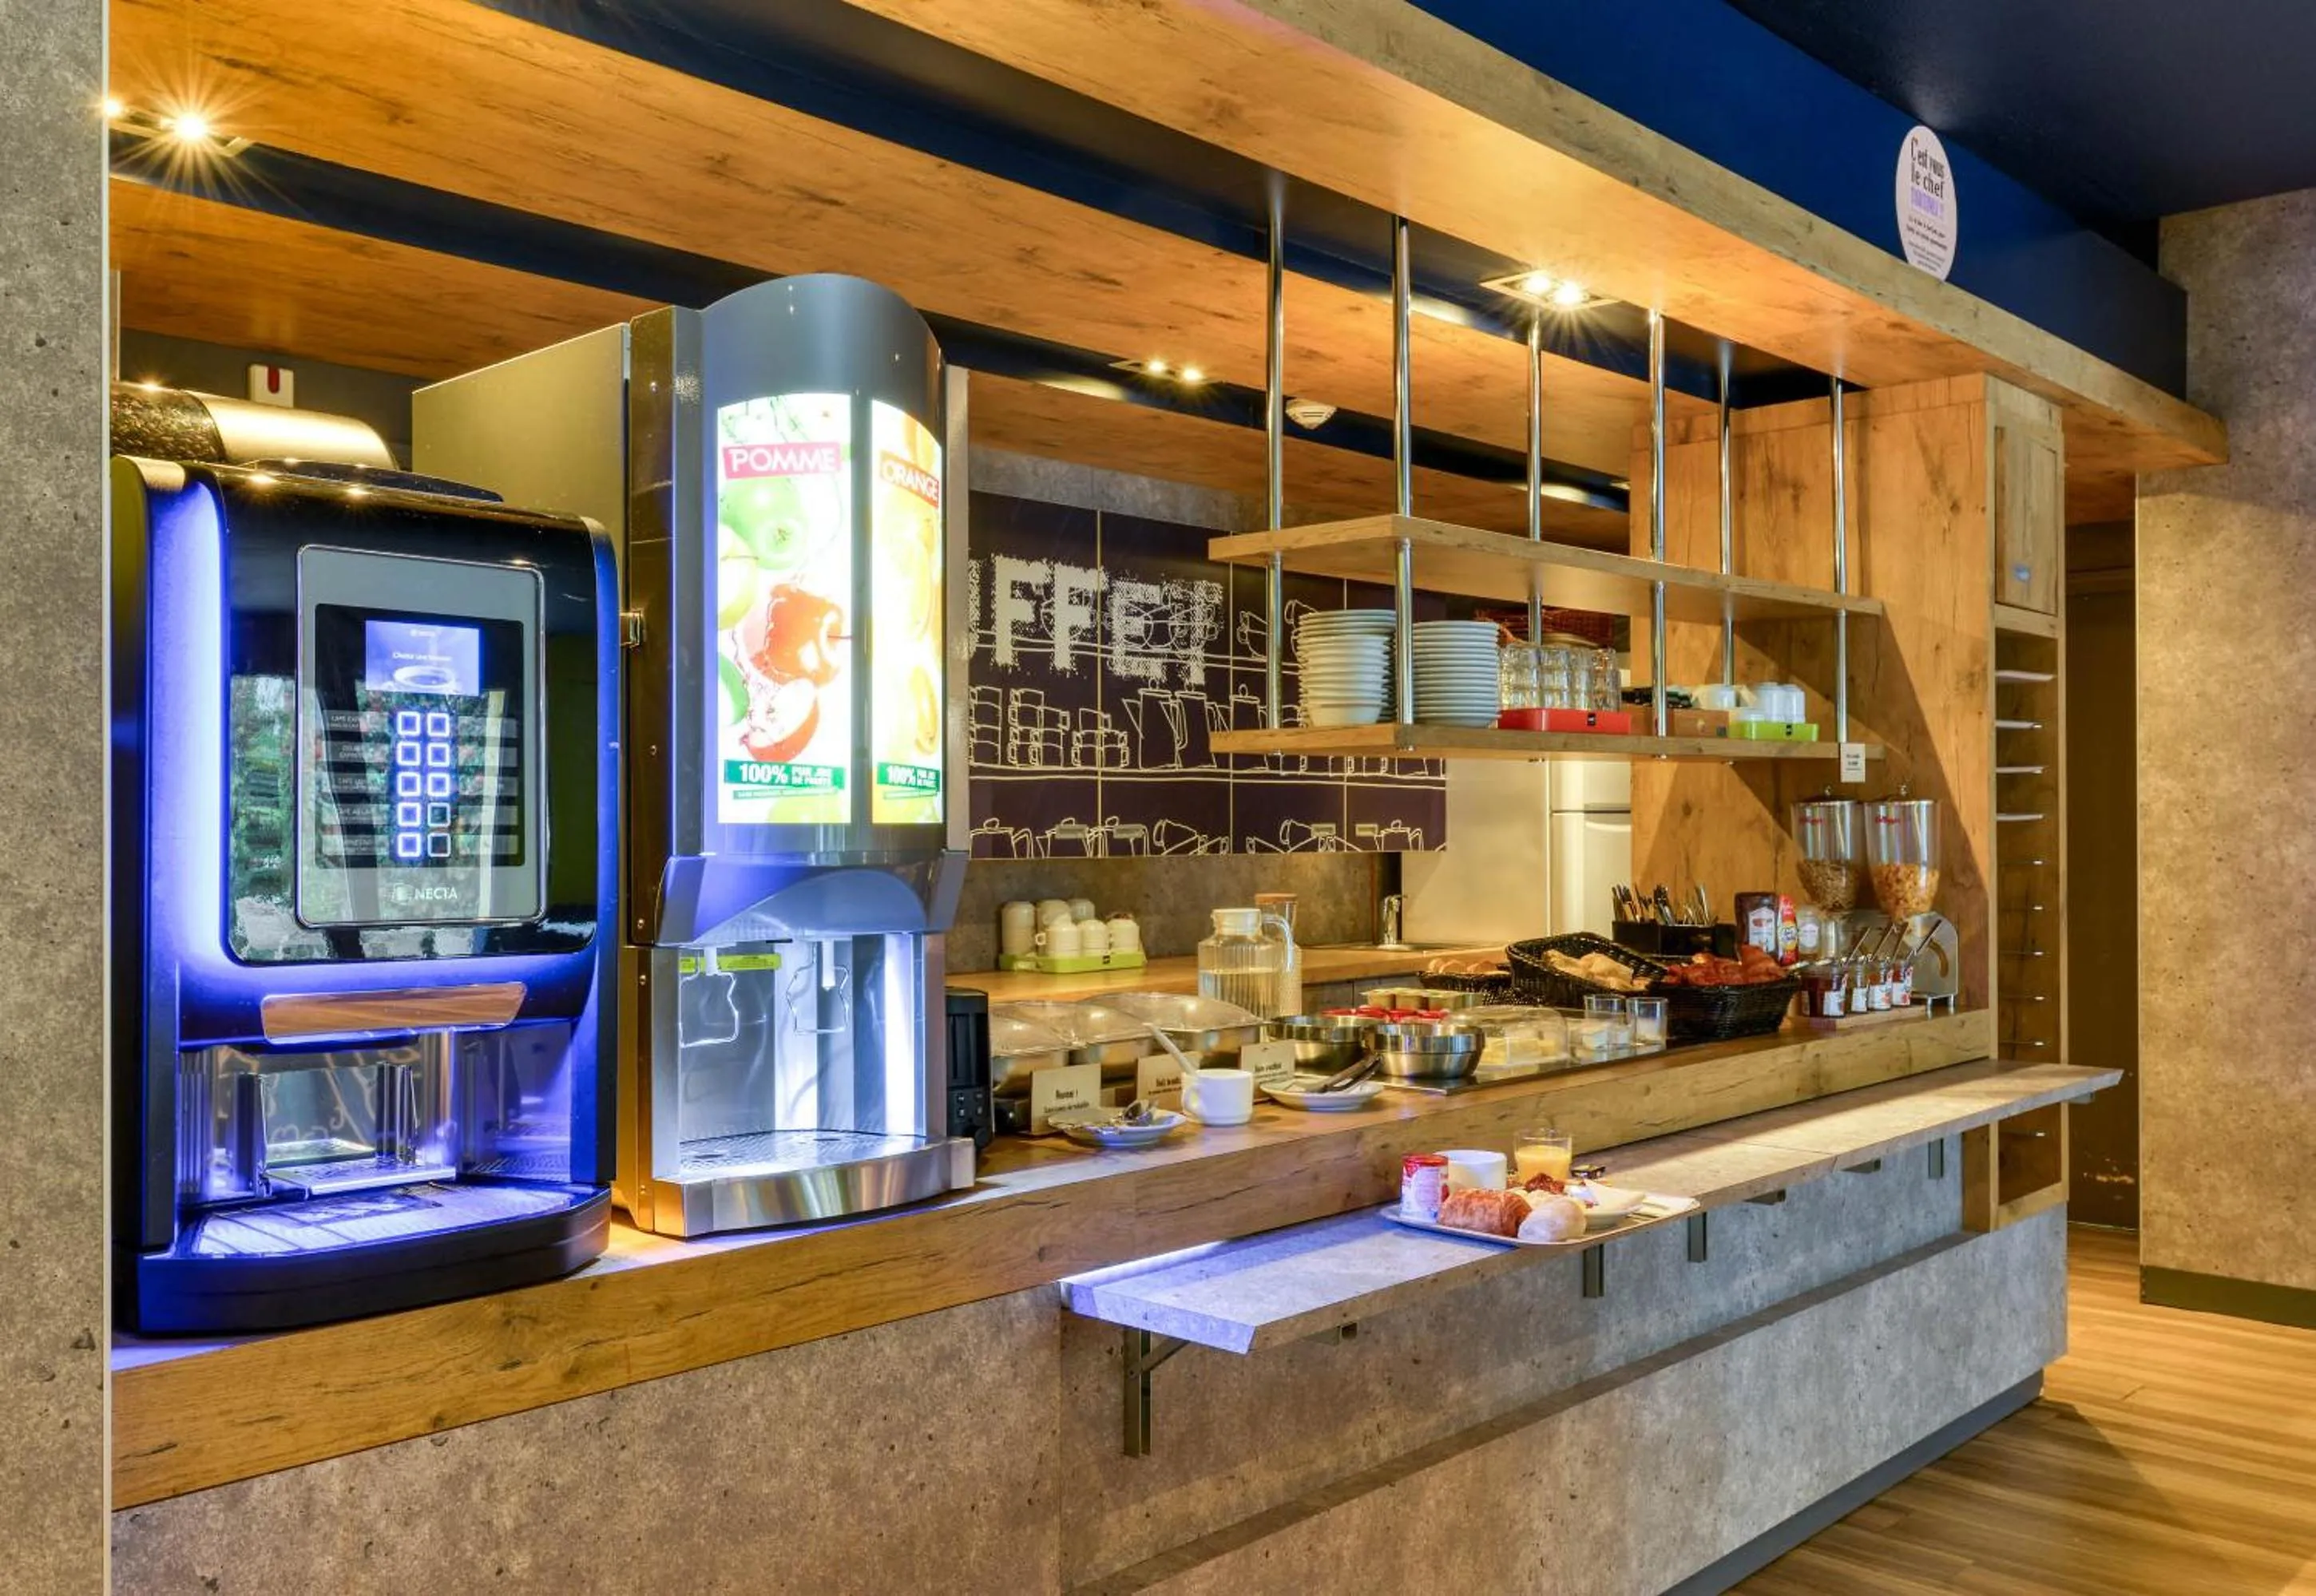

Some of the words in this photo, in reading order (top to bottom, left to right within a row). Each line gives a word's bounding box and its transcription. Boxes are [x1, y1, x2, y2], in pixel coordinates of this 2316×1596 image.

[1923, 172, 1945, 199] chef
[728, 446, 836, 473] POMME
[882, 461, 939, 501] ORANGE
[969, 551, 1223, 686] FFET
[739, 763, 789, 784] 100%
[414, 886, 458, 901] NECTA
